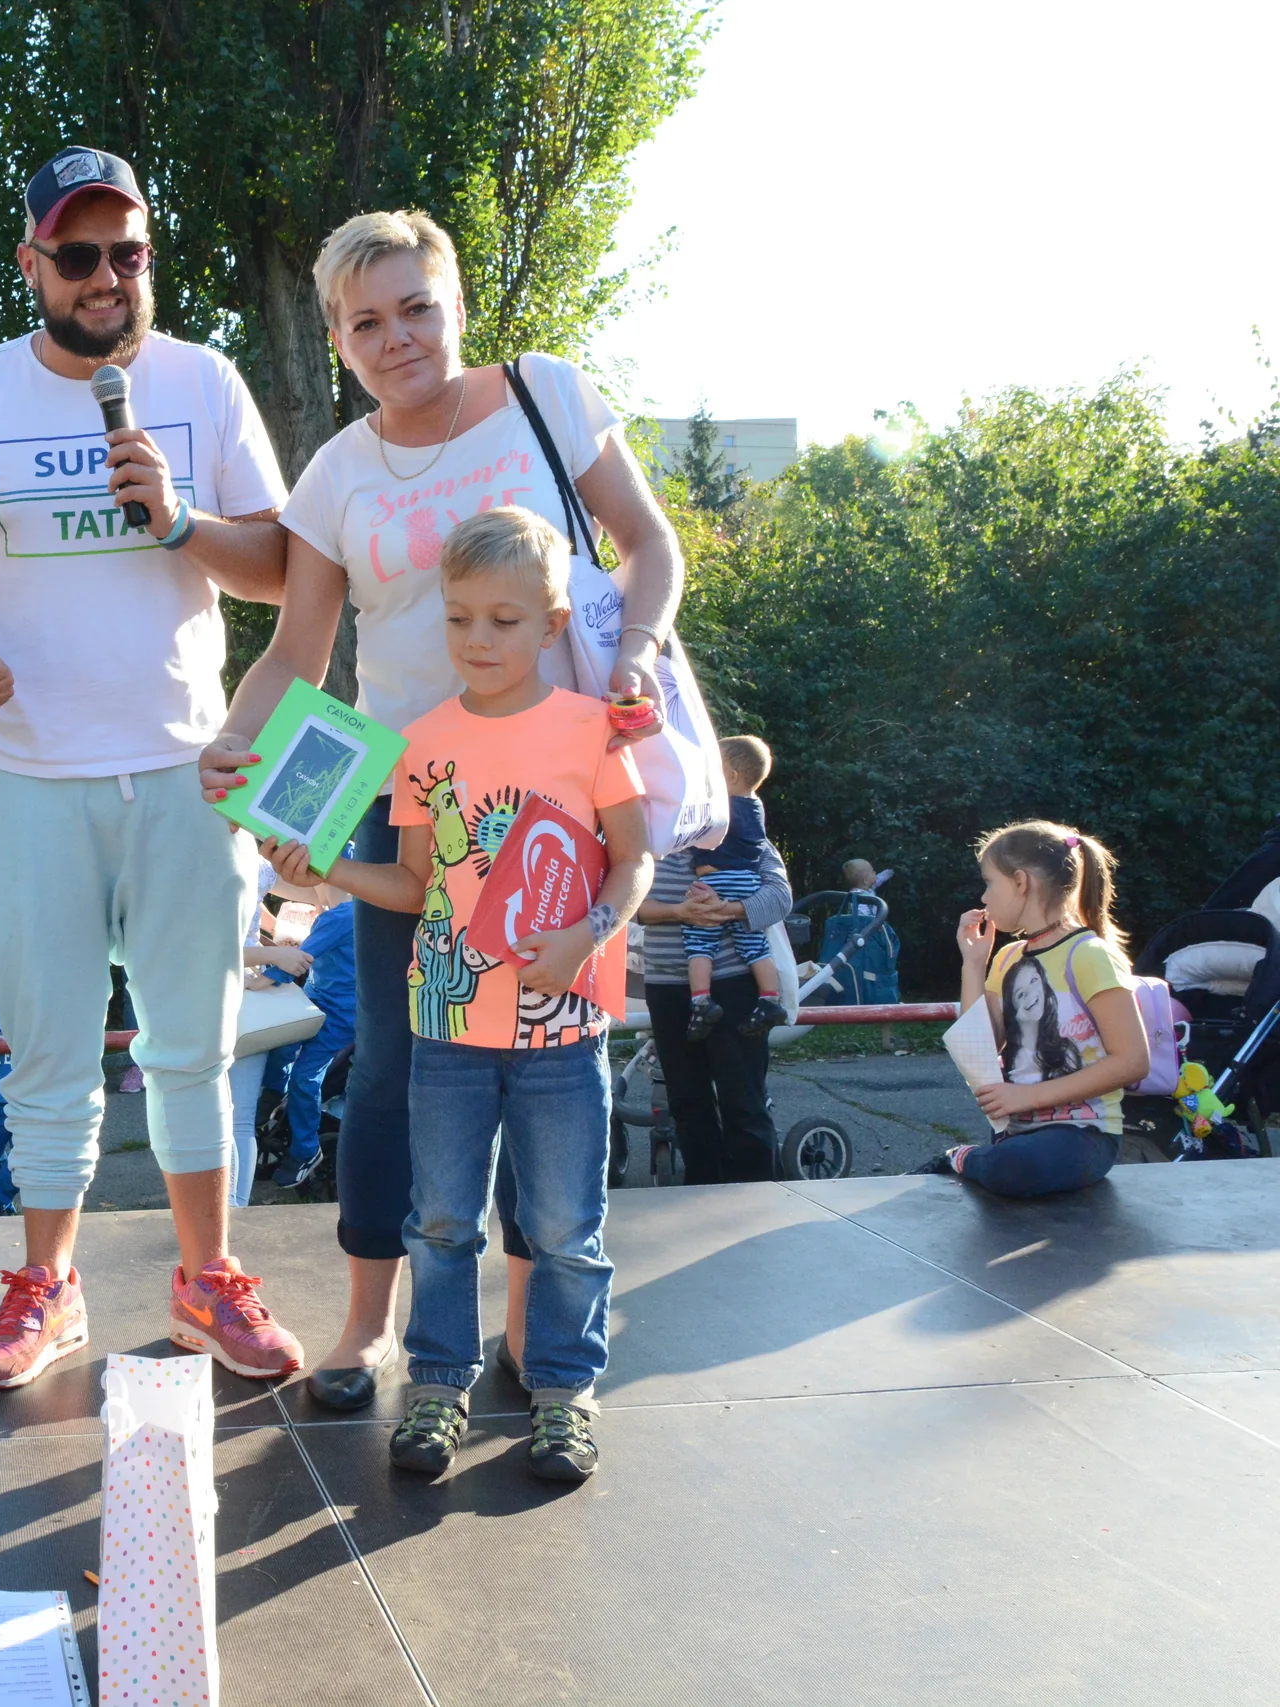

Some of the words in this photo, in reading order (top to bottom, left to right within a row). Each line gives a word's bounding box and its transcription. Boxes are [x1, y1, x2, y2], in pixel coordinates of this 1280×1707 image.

[366, 449, 535, 528] Summer
[326, 704, 366, 732] CAVION
[530, 858, 560, 933] Fundacja
[550, 866, 574, 928] Sercem
